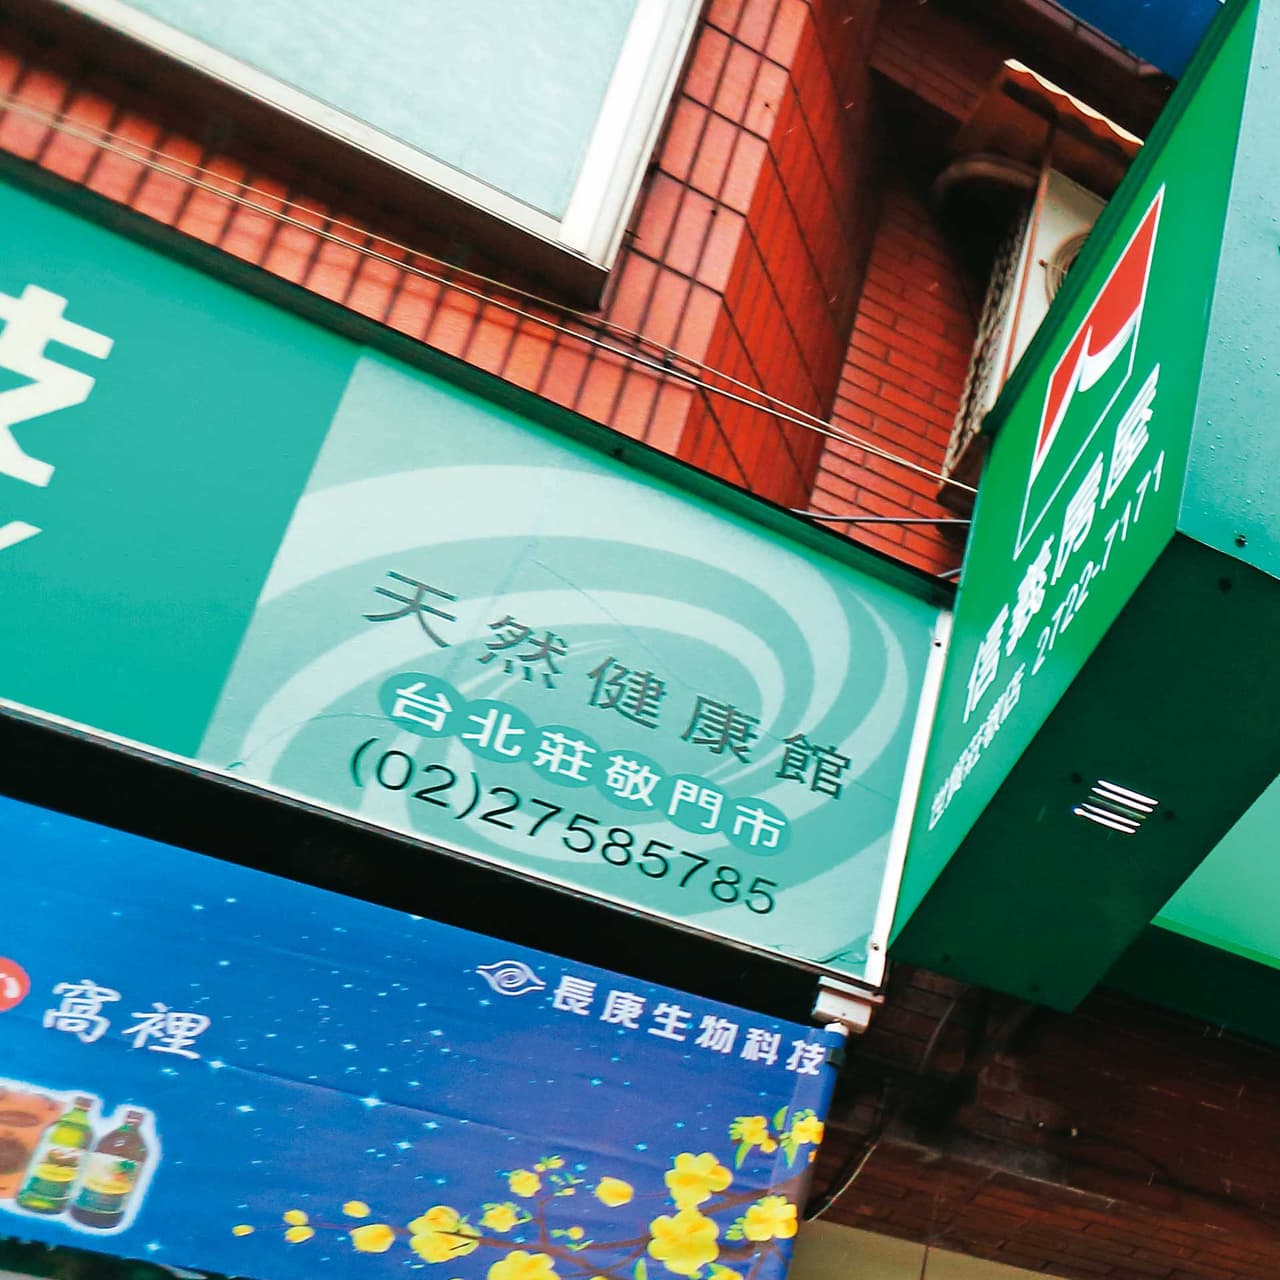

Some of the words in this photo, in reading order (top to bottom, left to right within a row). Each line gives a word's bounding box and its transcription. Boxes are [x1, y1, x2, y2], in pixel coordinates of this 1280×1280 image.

[1032, 450, 1166, 677] 2722-7171
[363, 570, 852, 800] 天然健康館
[388, 680, 787, 851] 台北莊敬門市
[349, 736, 777, 916] (02)27585785
[41, 980, 212, 1060] 窩裡
[552, 976, 827, 1076] 長庚生物科技
